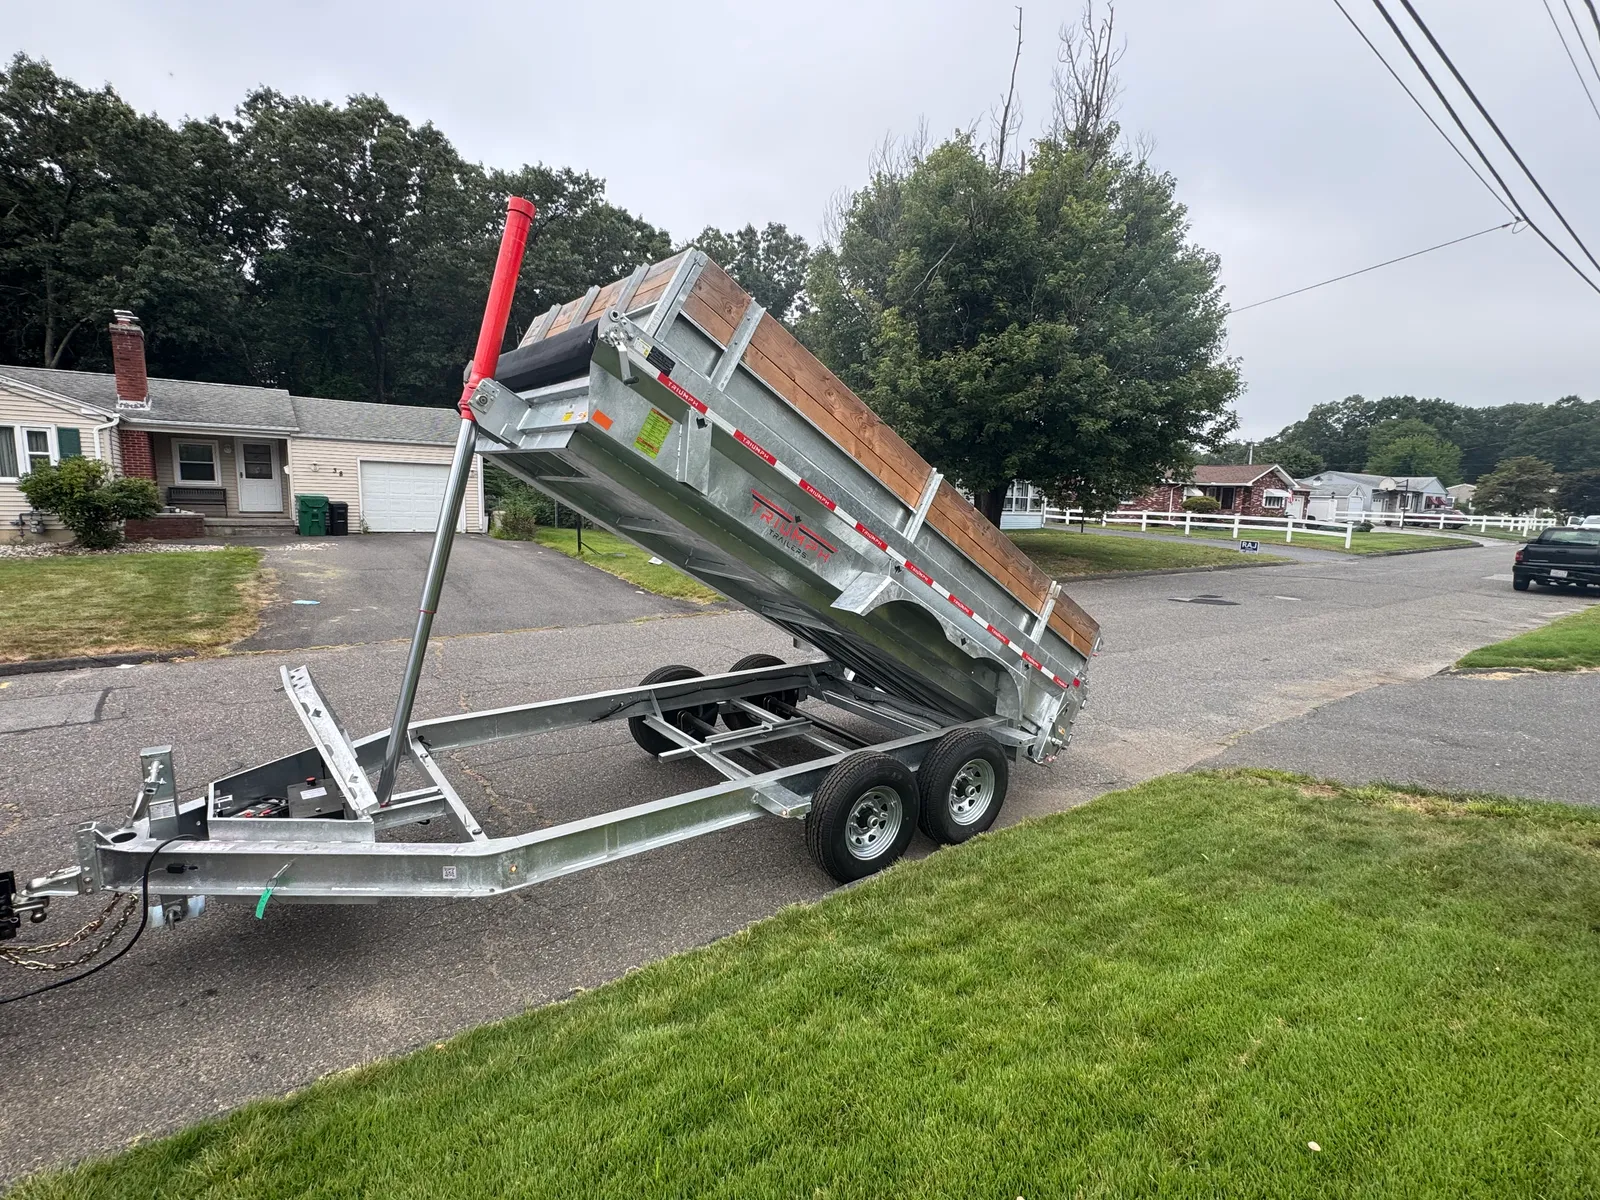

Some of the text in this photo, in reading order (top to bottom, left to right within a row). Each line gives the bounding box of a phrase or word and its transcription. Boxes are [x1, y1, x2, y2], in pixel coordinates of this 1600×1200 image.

[667, 381, 699, 407] TRIUMPH
[742, 437, 769, 460] TRIUMPH
[806, 485, 830, 506] TRIUMPH
[751, 500, 831, 563] TRIUMPH
[861, 528, 882, 546] TRIUMPH
[768, 528, 808, 559] TRAILERS
[1242, 541, 1257, 549] RAJ
